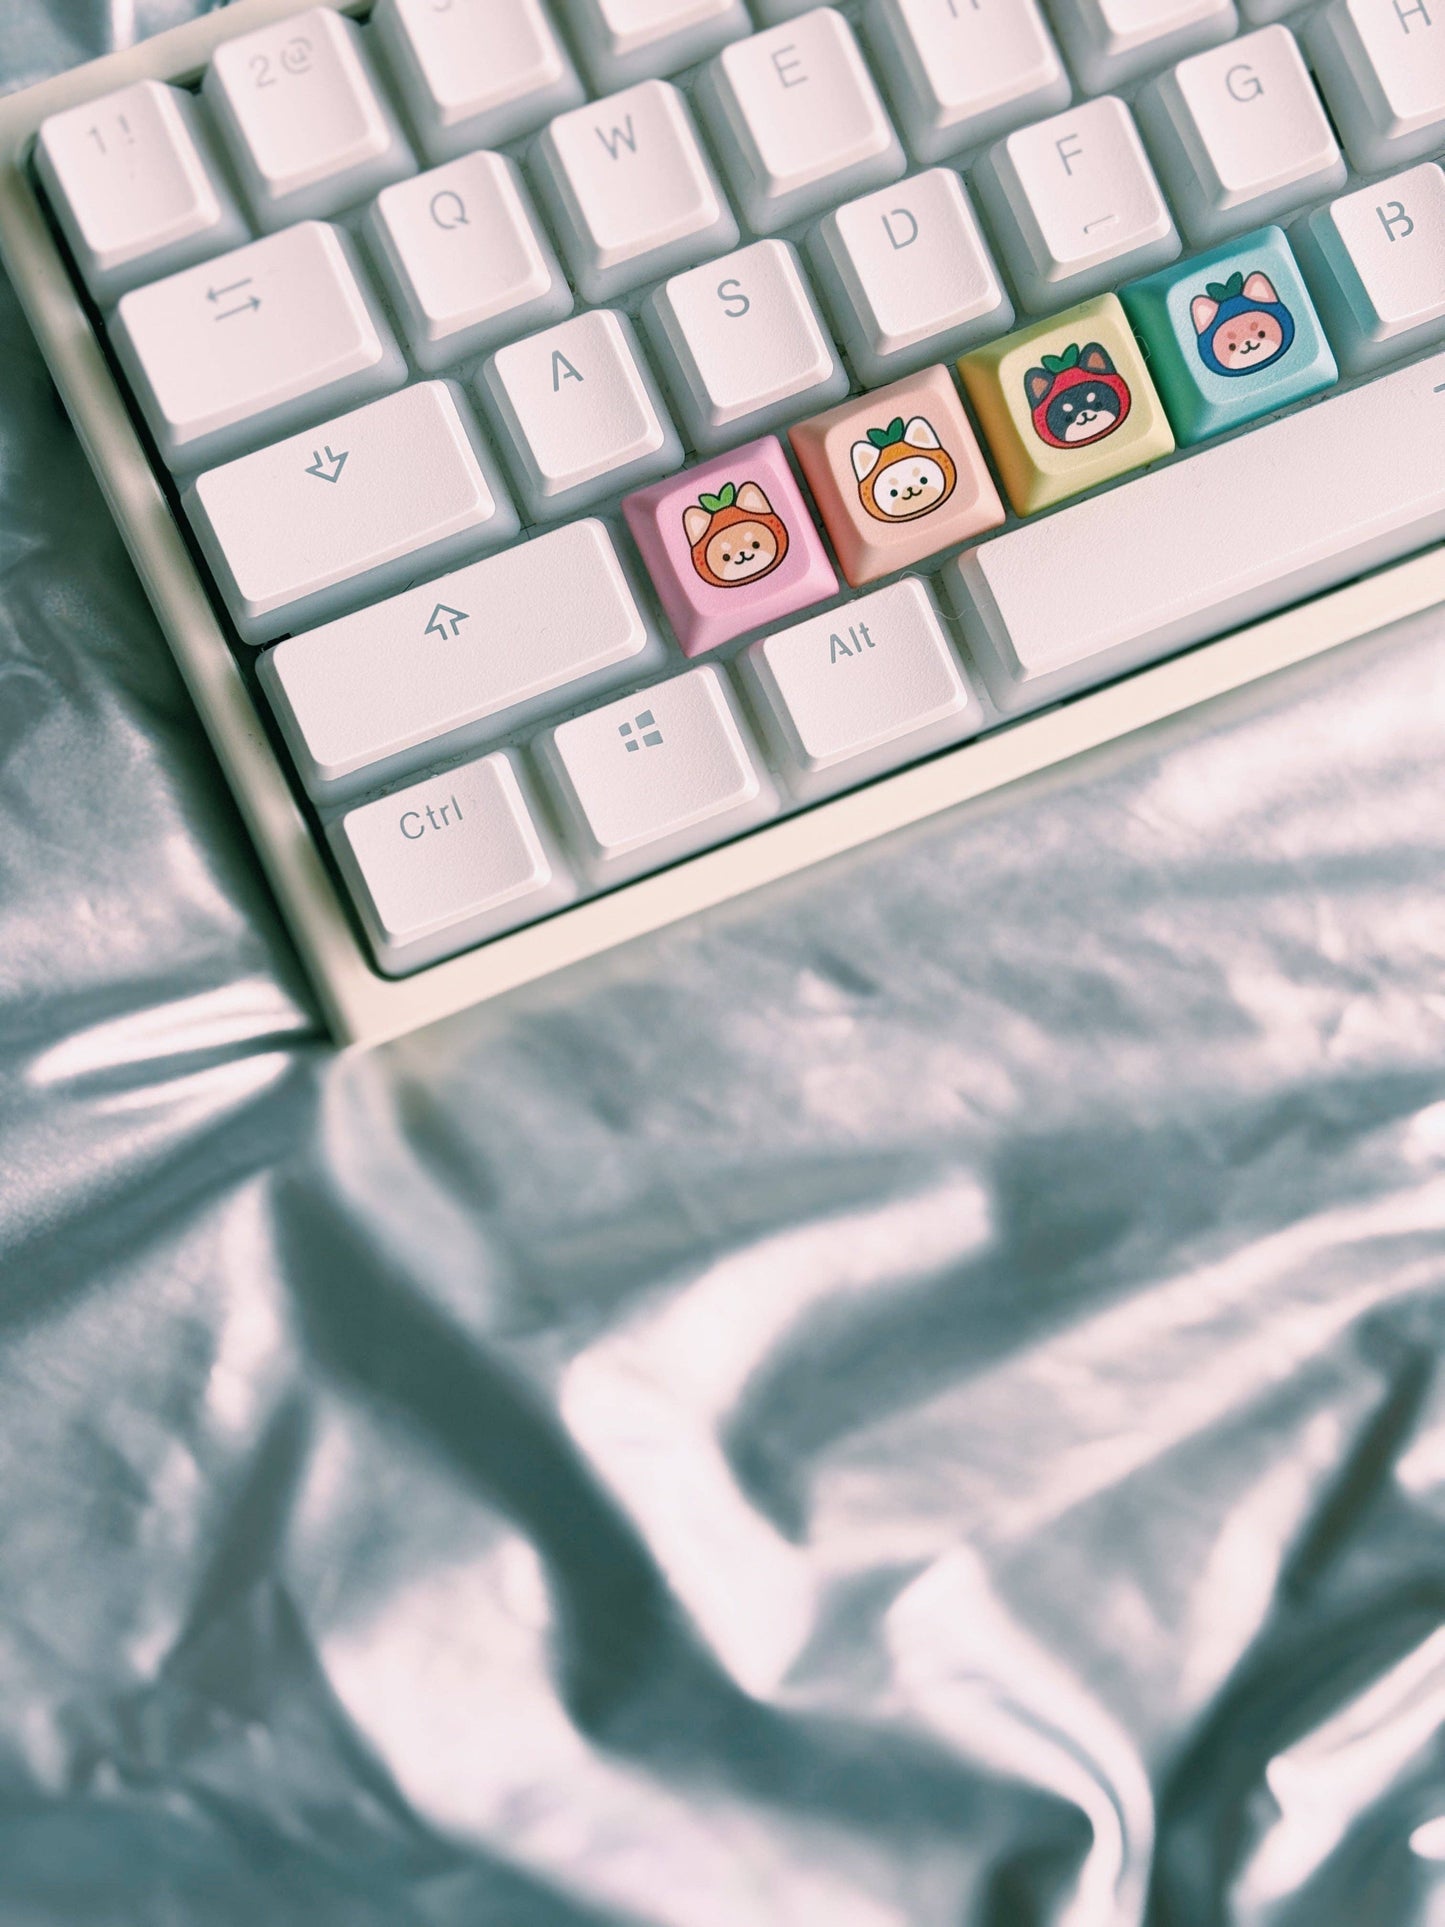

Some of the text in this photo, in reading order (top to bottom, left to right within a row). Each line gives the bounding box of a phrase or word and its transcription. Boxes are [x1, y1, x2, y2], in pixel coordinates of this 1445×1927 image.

[1392, 0, 1432, 34] H
[771, 45, 809, 89] E
[1225, 64, 1264, 102] G
[595, 115, 637, 160] W
[1055, 134, 1085, 176] F
[430, 190, 470, 230] Q
[881, 208, 919, 250] D
[1375, 200, 1414, 242] B
[717, 279, 750, 318] S
[551, 350, 583, 392] A
[829, 622, 876, 664] Alt
[399, 795, 463, 841] Ctrl
